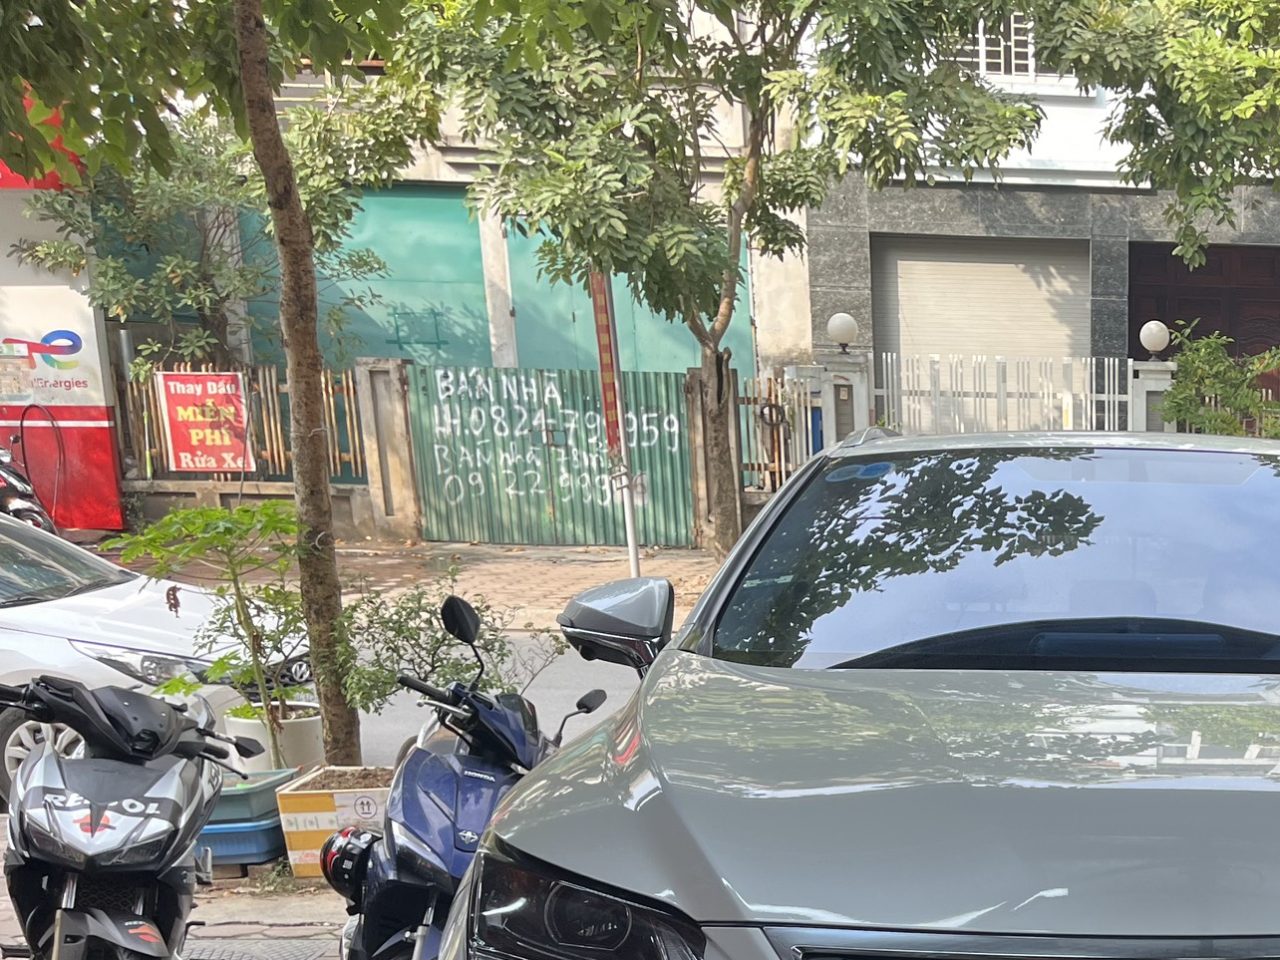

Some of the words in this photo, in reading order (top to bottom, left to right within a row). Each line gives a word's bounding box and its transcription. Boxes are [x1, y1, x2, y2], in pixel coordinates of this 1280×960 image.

[167, 381, 203, 396] Thay
[179, 450, 217, 468] Rửa
[221, 452, 246, 468] Xe
